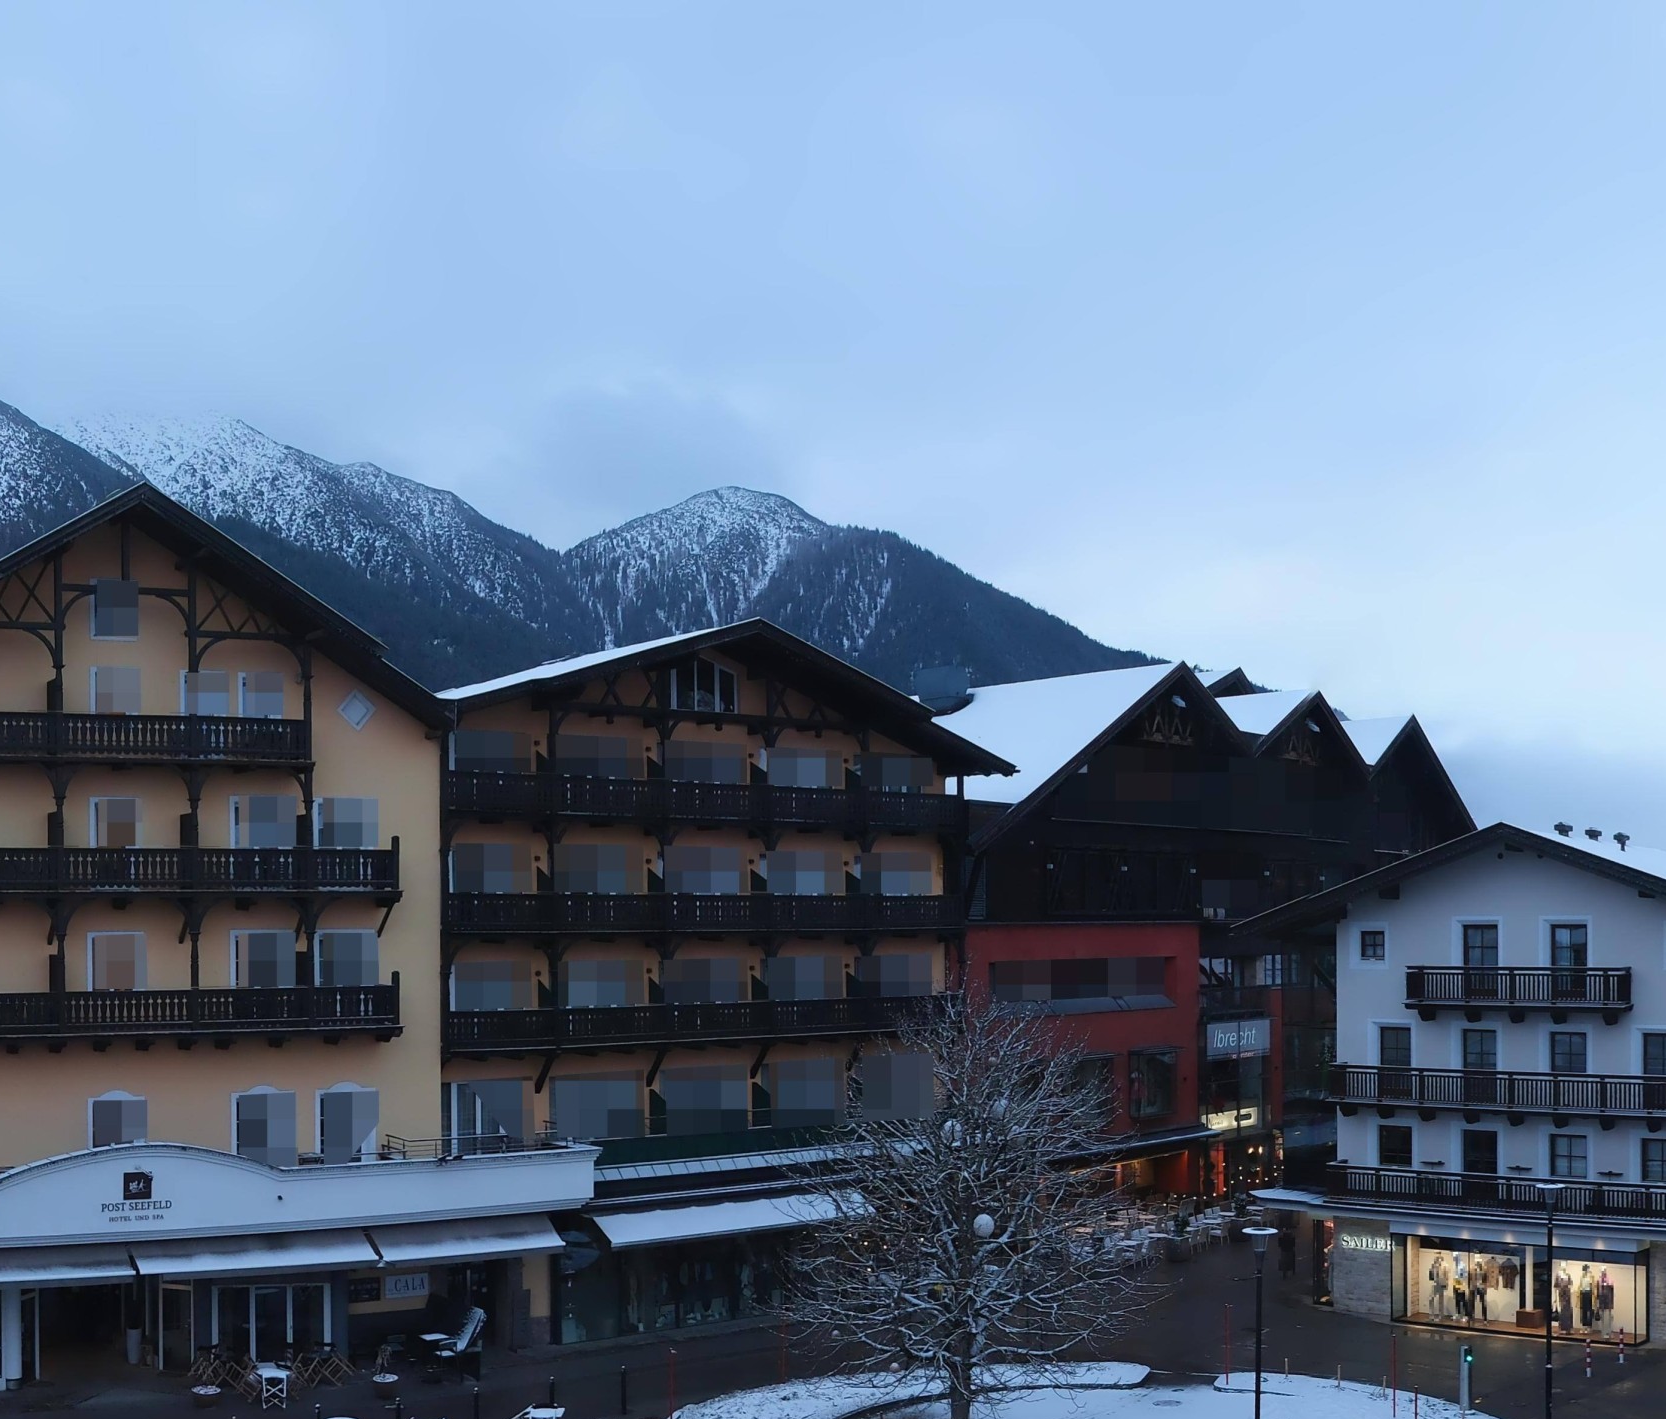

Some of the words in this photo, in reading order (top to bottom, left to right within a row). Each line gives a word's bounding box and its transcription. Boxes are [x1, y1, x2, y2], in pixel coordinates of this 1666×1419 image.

[101, 1202, 127, 1213] POST
[128, 1200, 173, 1211] SEEFELD
[108, 1215, 133, 1223] HOTEL
[1341, 1234, 1396, 1252] SAILER
[394, 1276, 426, 1292] CALA
